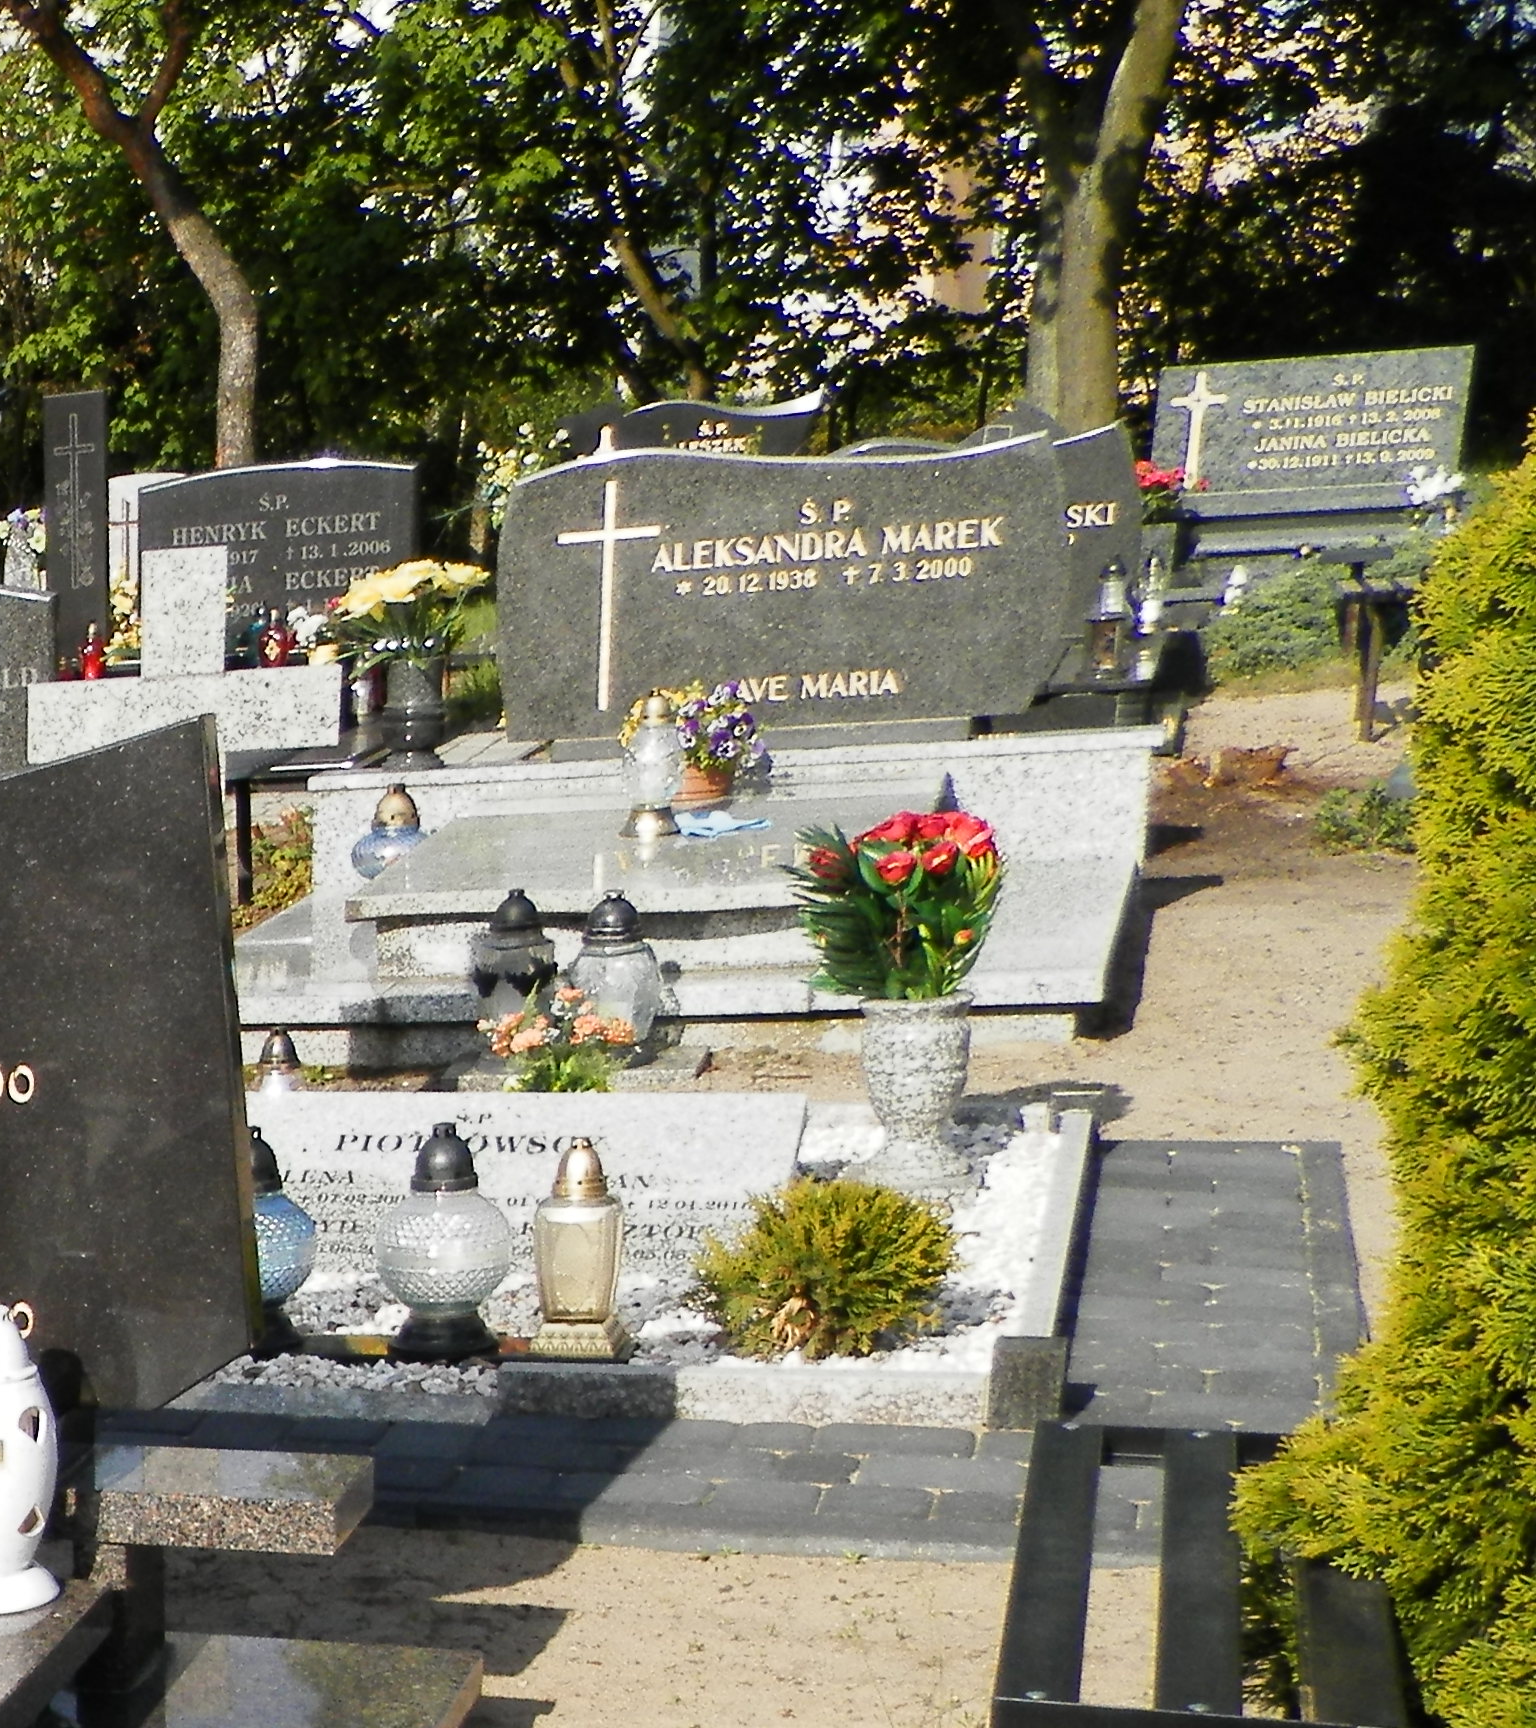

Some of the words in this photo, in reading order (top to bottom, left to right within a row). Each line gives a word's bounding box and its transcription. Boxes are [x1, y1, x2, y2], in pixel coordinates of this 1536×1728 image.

[1242, 392, 1356, 414] STANISŁAW
[1364, 386, 1454, 406] BIELICKI
[1254, 434, 1327, 453] JANINA
[1335, 428, 1432, 448] BIELICKA
[171, 520, 267, 546] HENRYK
[285, 511, 381, 538] ECKERT
[651, 526, 868, 574] ALEKSANDRA
[882, 516, 1006, 555] MAREK
[734, 675, 789, 703] AVE
[801, 668, 900, 700] MARIA
